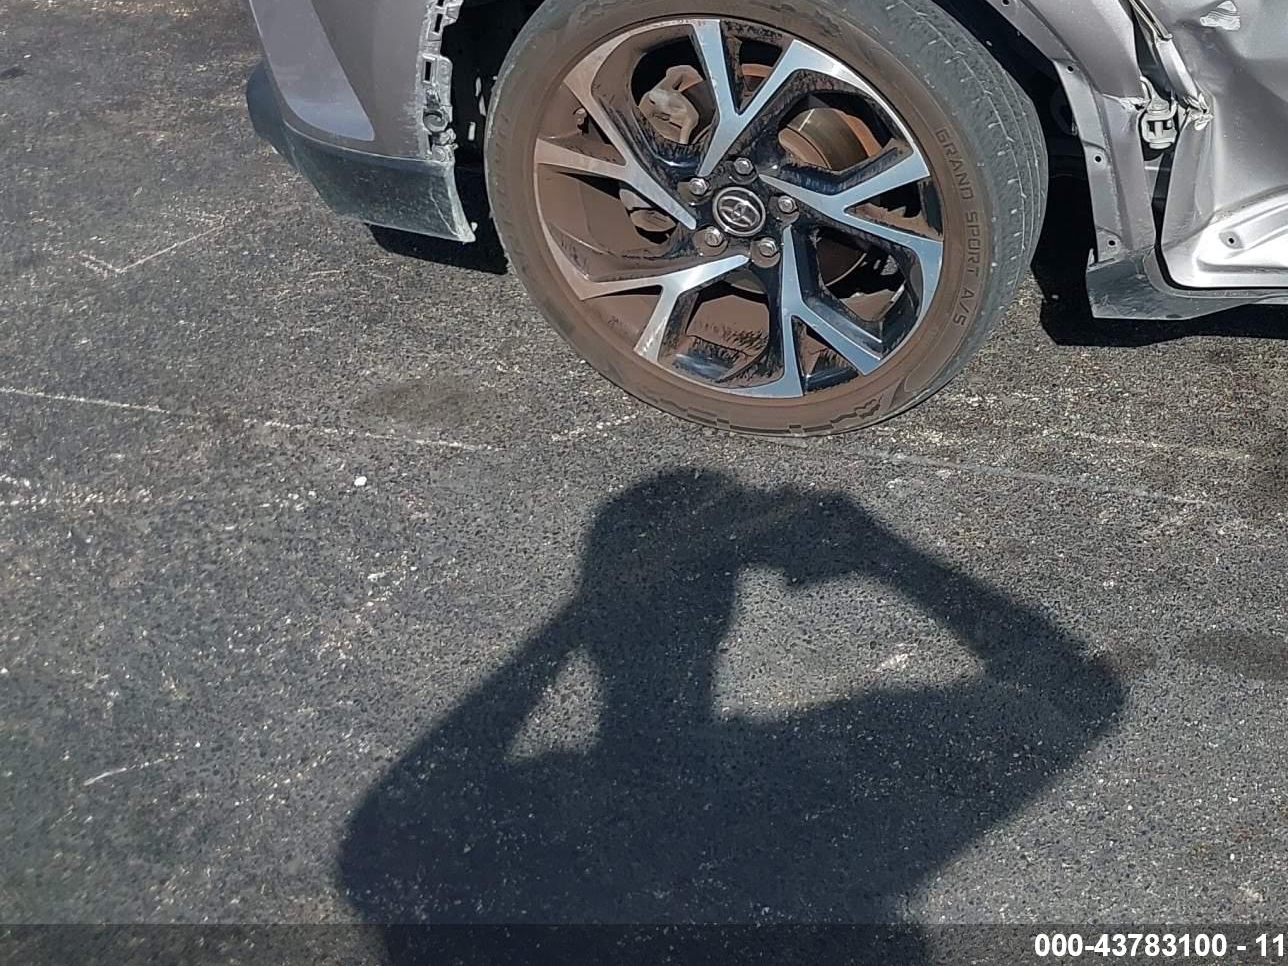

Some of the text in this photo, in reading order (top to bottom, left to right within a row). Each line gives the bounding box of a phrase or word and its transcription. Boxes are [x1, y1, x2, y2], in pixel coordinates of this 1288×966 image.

[935, 127, 981, 326] GRAND SPORT A/S
